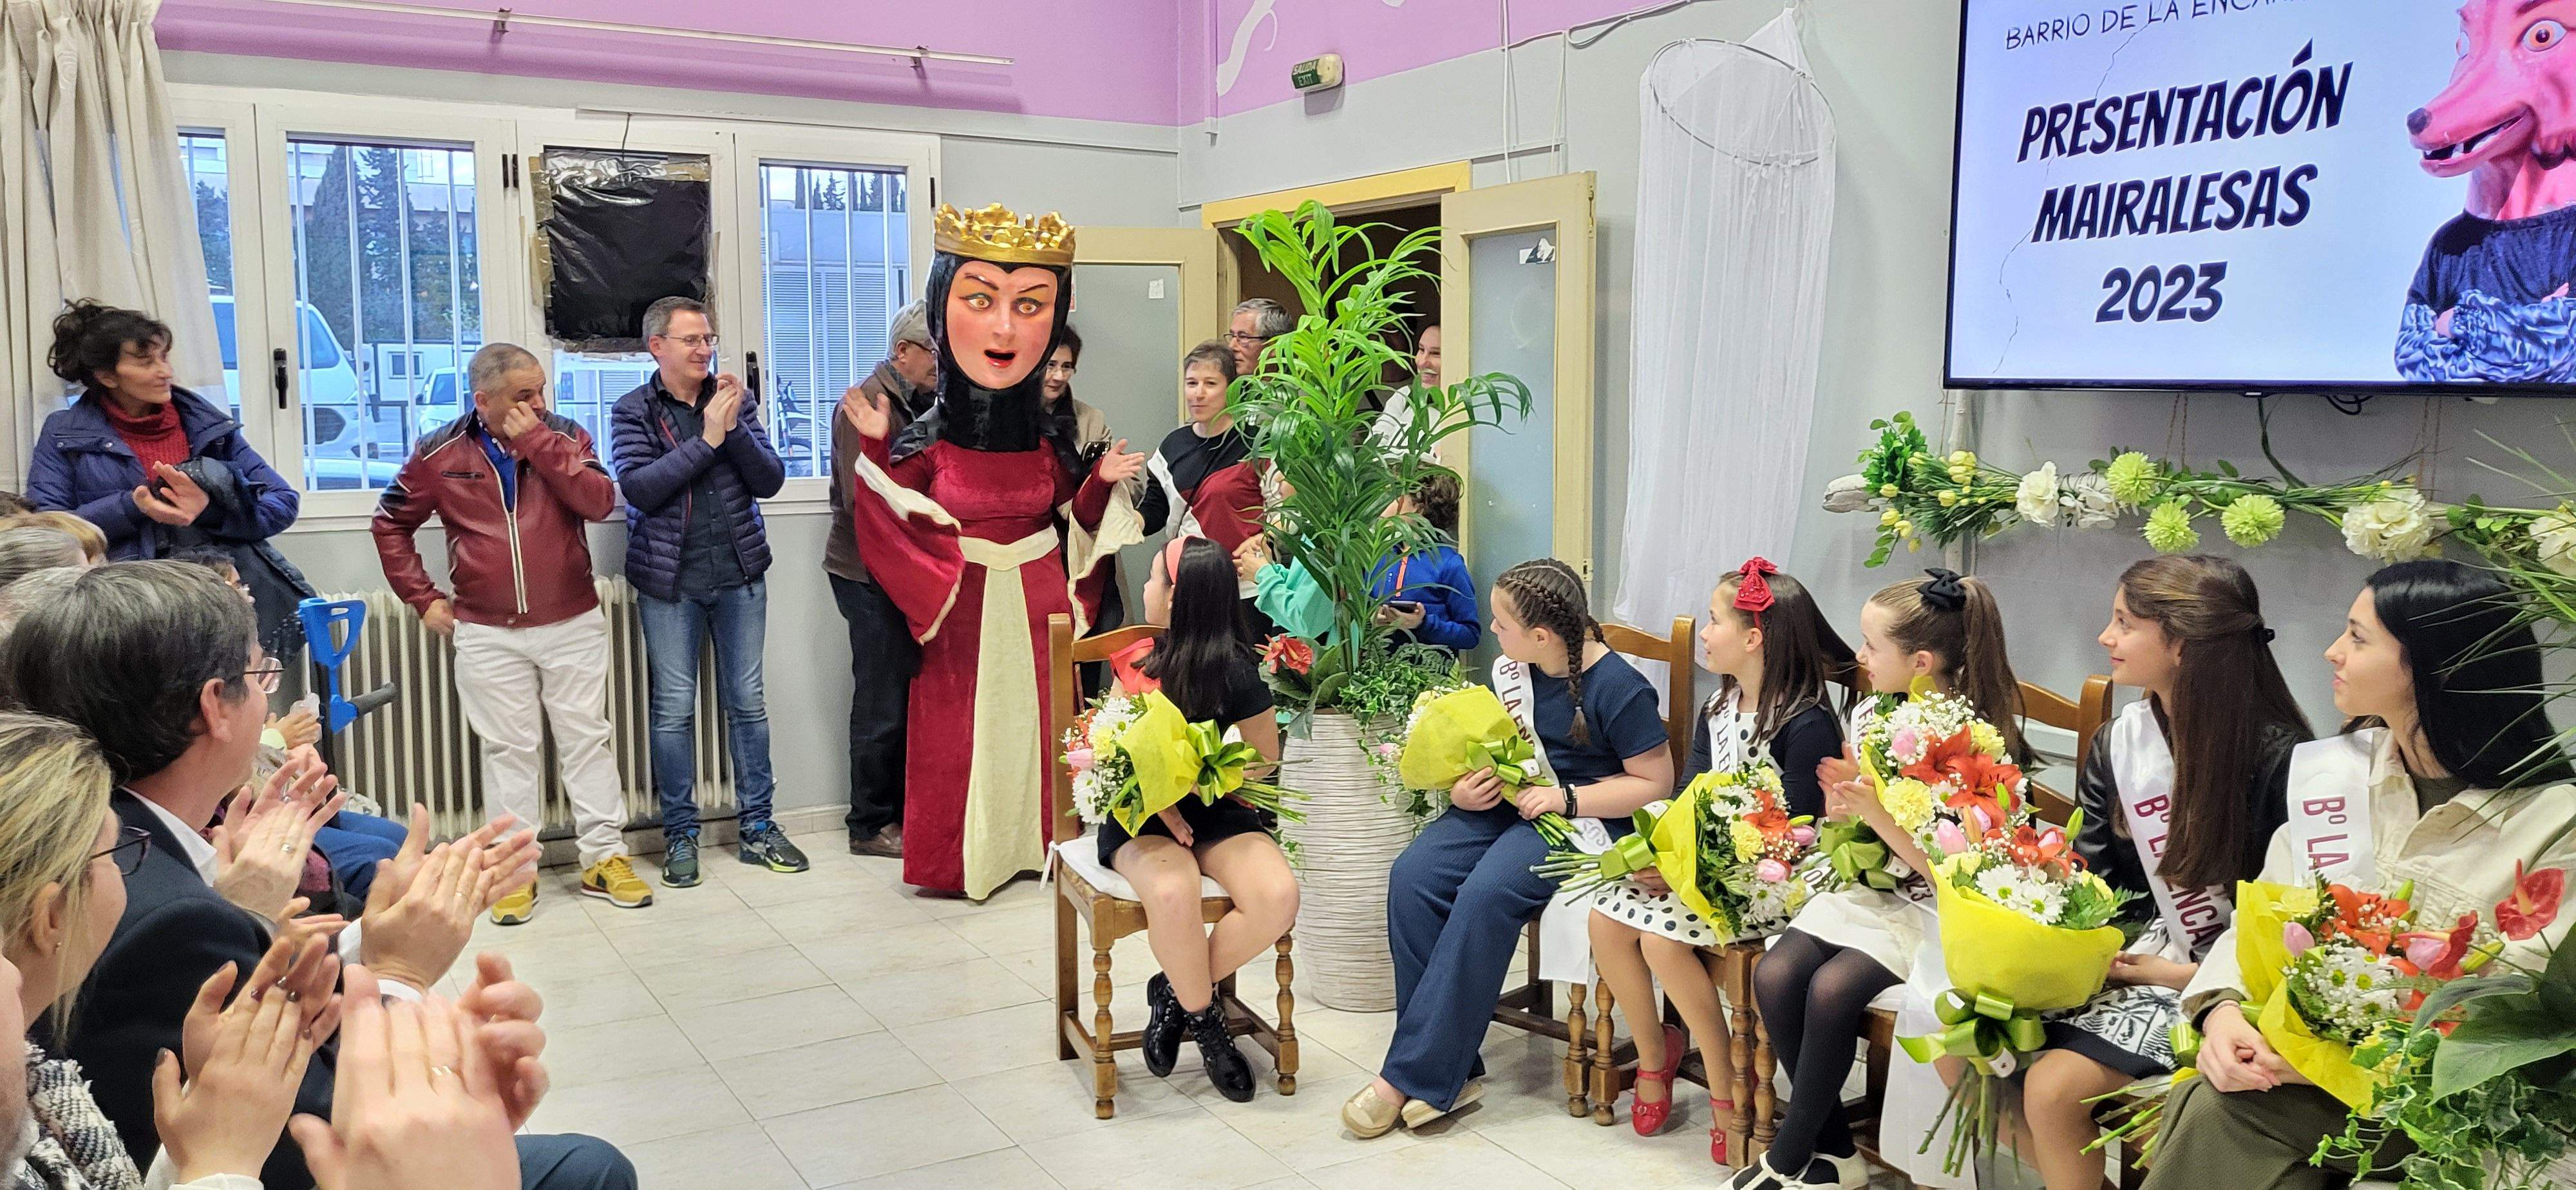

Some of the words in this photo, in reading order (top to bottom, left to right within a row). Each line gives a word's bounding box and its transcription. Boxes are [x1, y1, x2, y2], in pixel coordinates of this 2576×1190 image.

[2006, 13, 2090, 50] BARRIO
[2101, 5, 2137, 33] DE
[2147, 0, 2179, 23] LA
[1298, 73, 1313, 86] EXIT
[2016, 37, 2354, 164] PRESENTACIÓN
[2030, 164, 2318, 243] MAIRALESAS
[2095, 260, 2228, 323] 2023
[1501, 685, 1522, 713] LA
[1716, 723, 1728, 755] LA
[2307, 833, 2349, 871] LA
